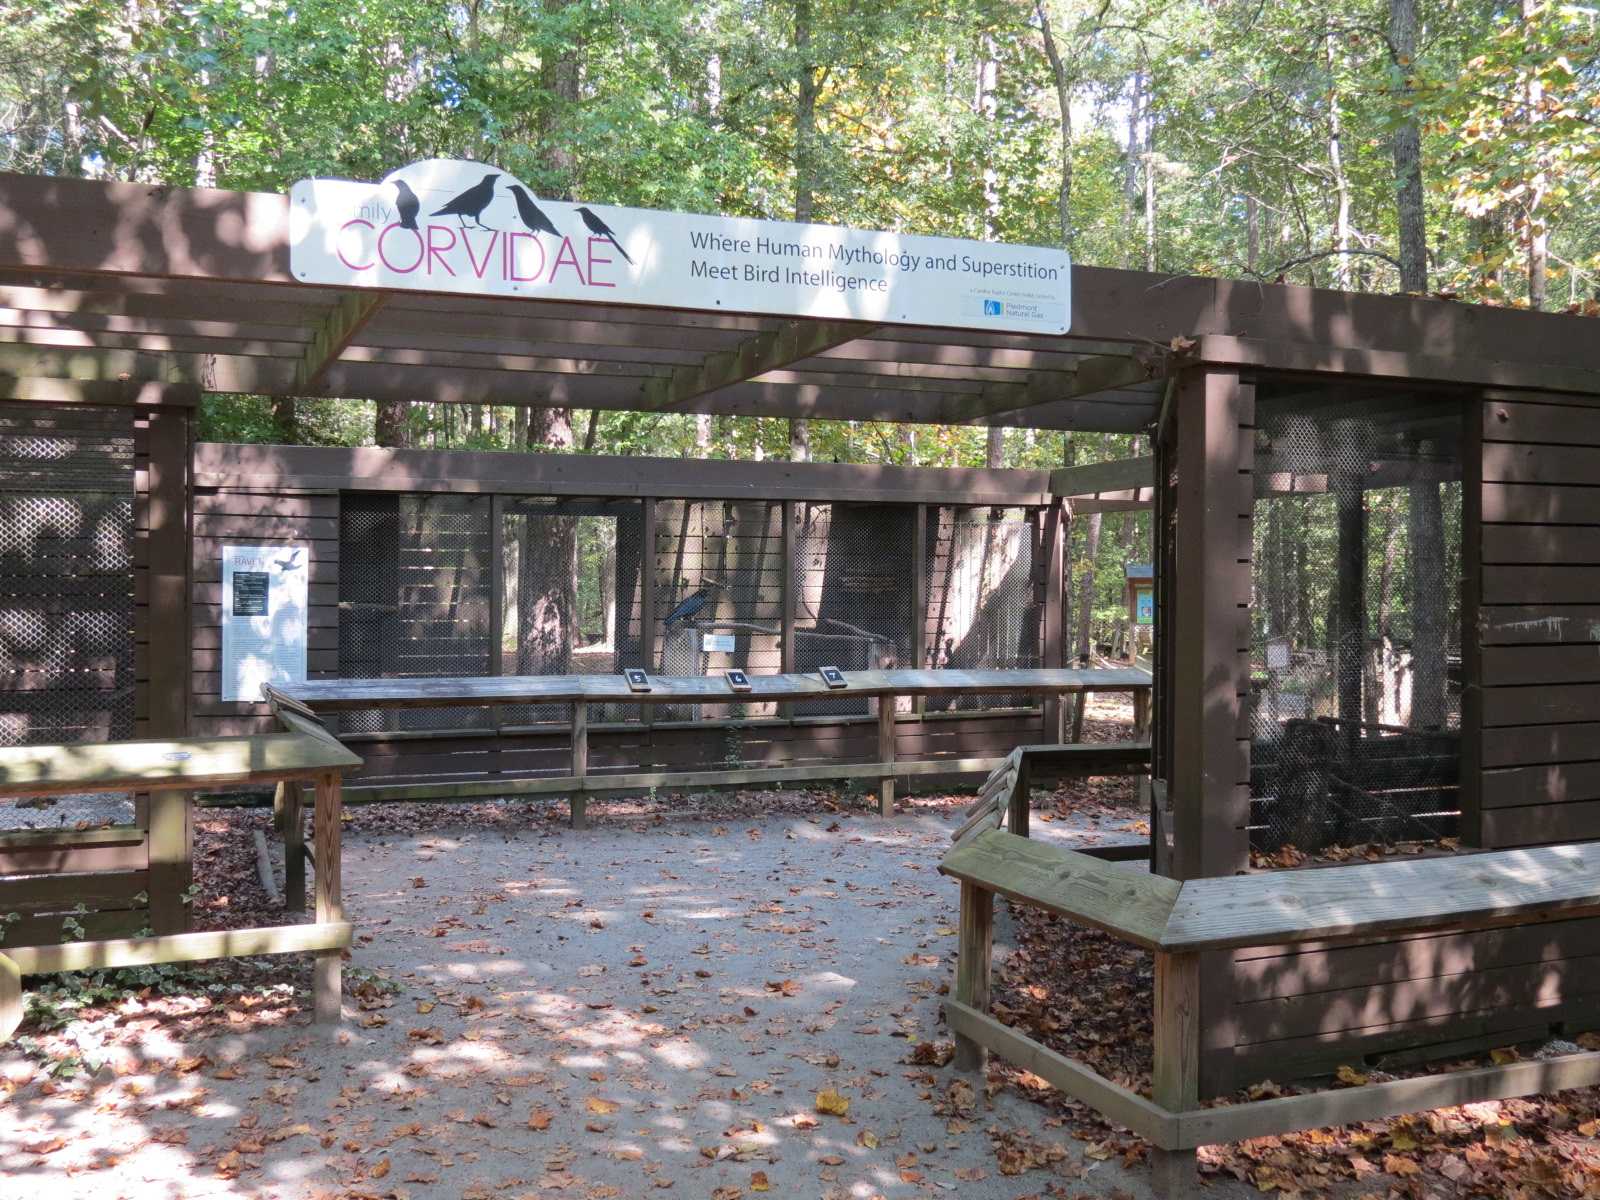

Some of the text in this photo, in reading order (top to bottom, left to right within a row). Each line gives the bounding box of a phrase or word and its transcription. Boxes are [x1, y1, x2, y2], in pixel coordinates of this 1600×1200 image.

[336, 218, 616, 288] CORVIDAE
[690, 231, 1059, 281] Where Human Mythology and Superstition
[691, 260, 888, 293] Meet Bird Intelligence
[1006, 302, 1038, 312] Piedmont
[1006, 309, 1044, 319] Natural Gas
[234, 557, 265, 566] RAVEN
[634, 674, 642, 683] 5
[734, 674, 742, 683] 6
[828, 672, 836, 680] 7
